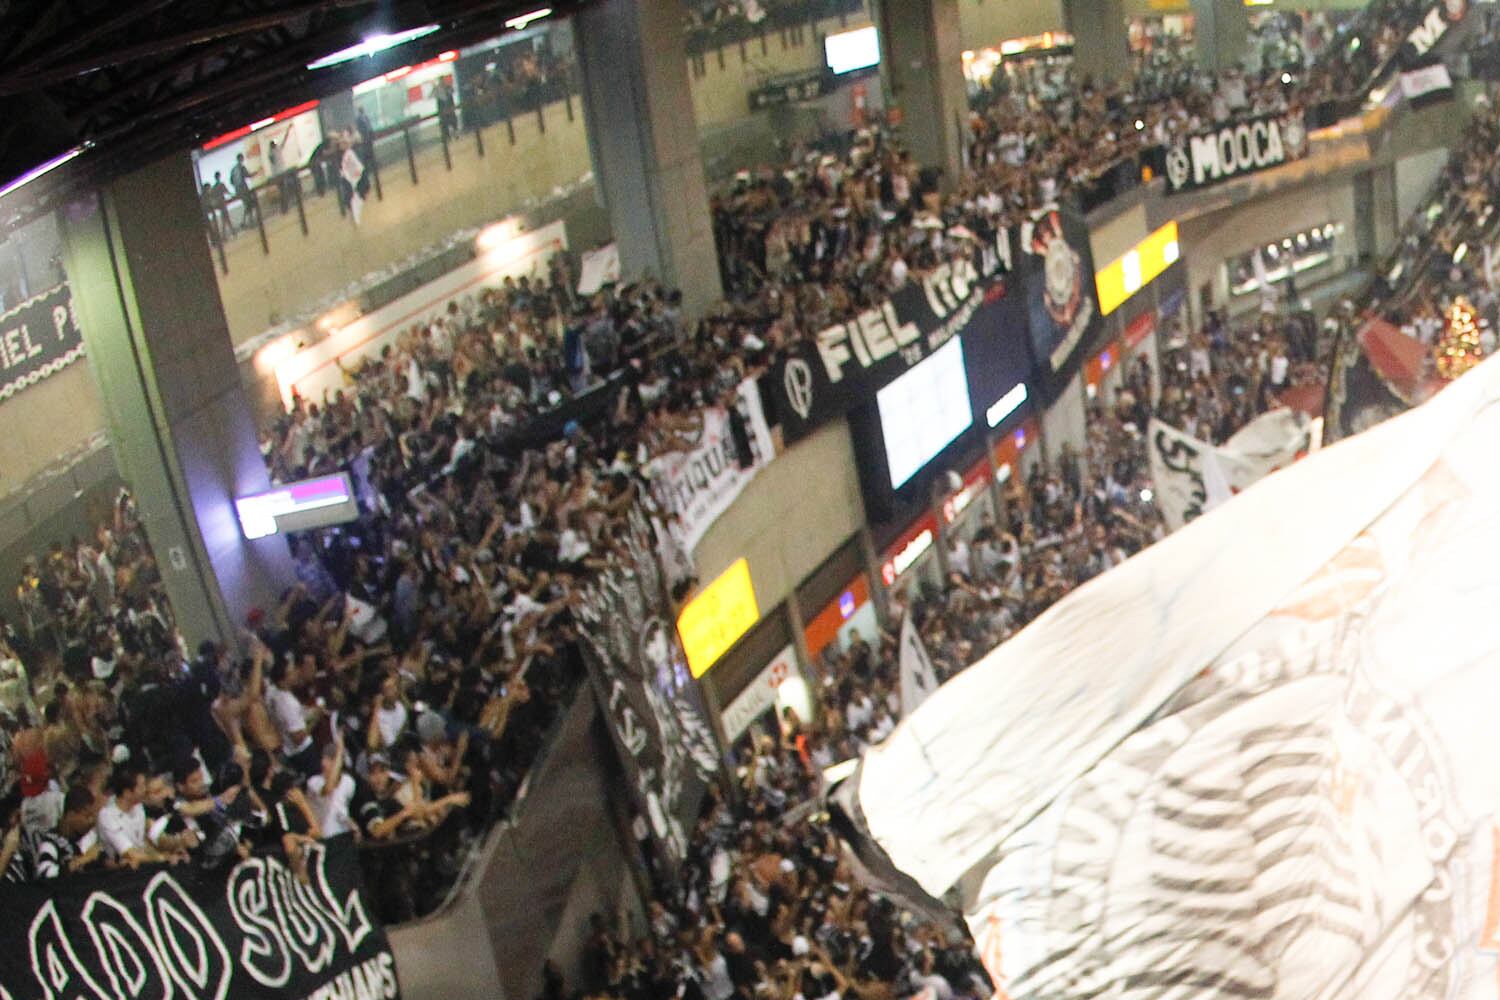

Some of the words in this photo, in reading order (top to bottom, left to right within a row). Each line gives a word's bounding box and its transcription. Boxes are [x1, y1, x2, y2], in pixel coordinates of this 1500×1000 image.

[1190, 119, 1286, 185] MOOCA
[0, 324, 43, 369] IEL
[816, 299, 921, 383] FIEL
[227, 842, 373, 988] SUL
